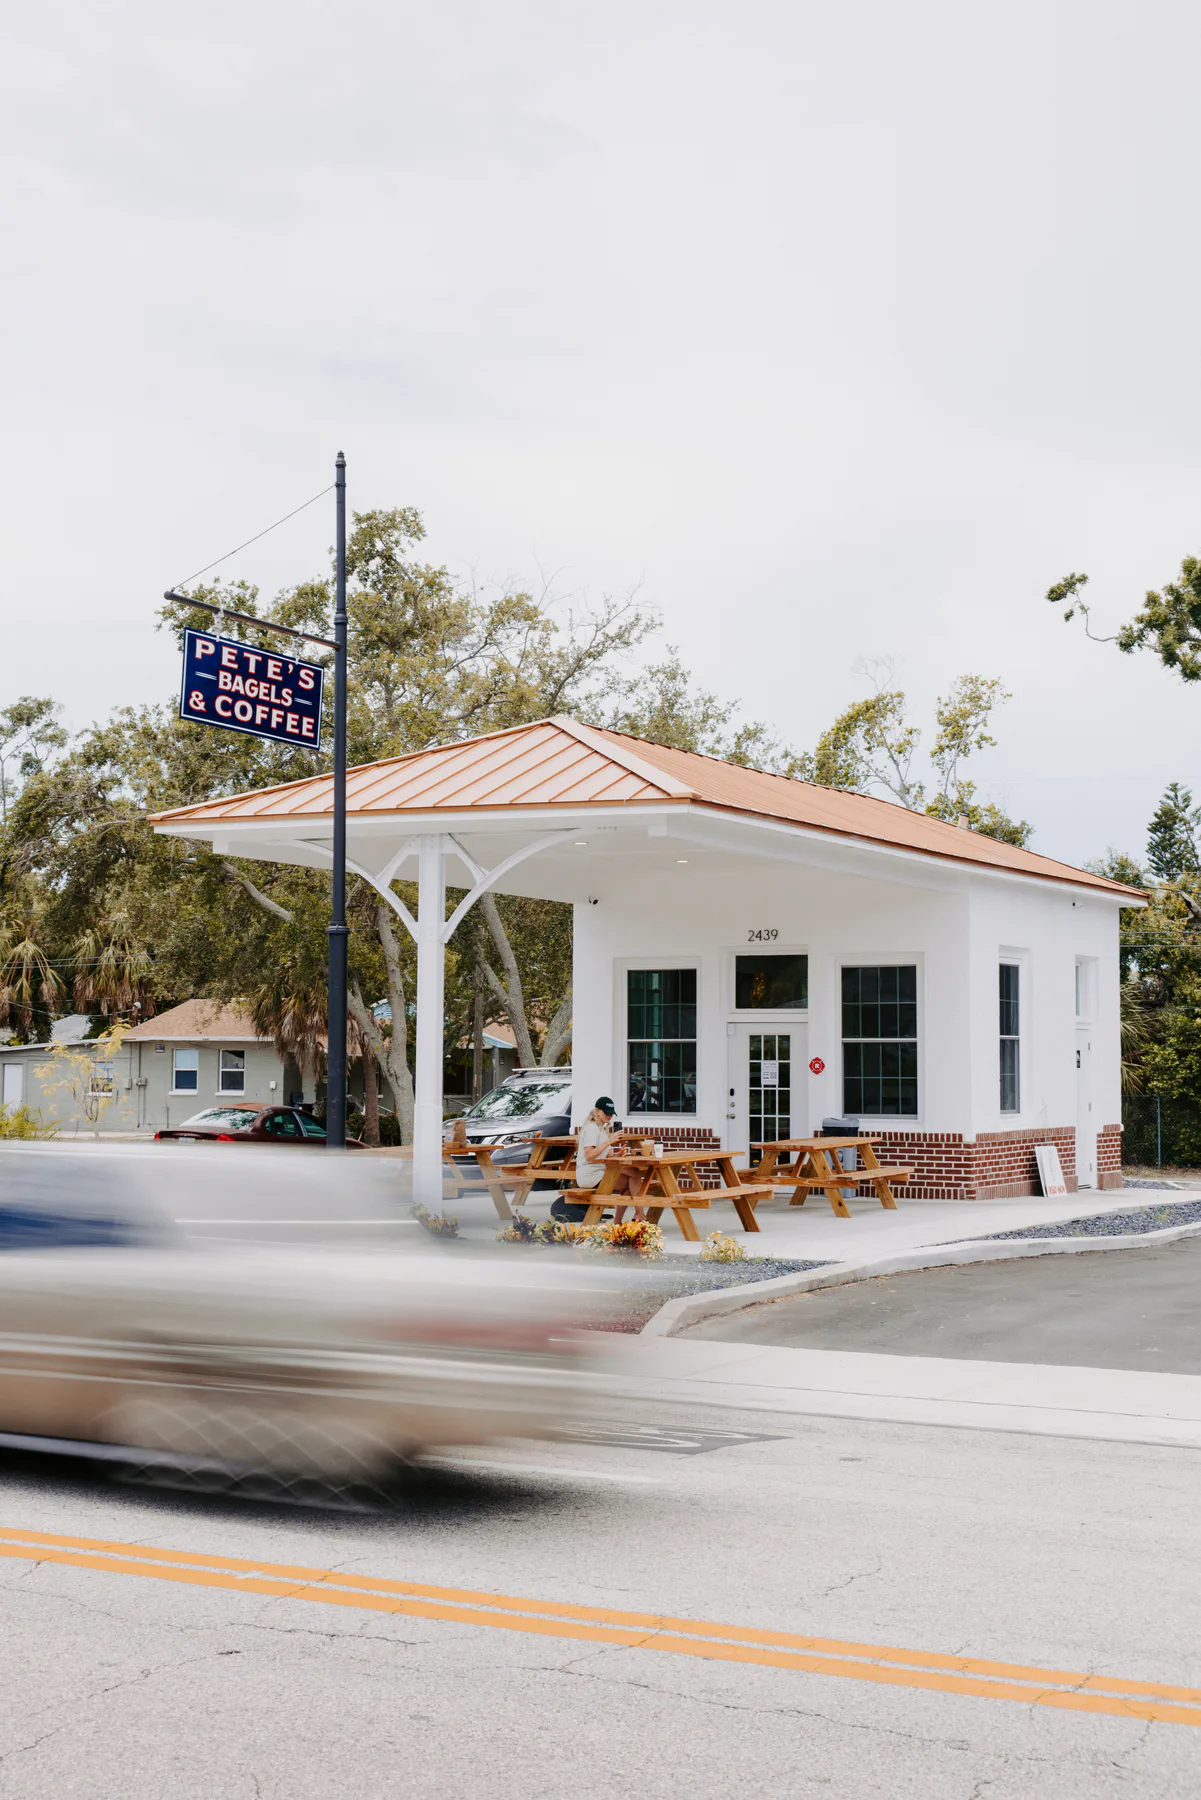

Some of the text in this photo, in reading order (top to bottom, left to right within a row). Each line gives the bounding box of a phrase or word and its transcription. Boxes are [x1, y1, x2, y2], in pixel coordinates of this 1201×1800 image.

[195, 638, 315, 690] PETE'S
[218, 670, 293, 707] BAGELS
[188, 690, 315, 738] & COFFEE
[747, 929, 779, 942] 2439
